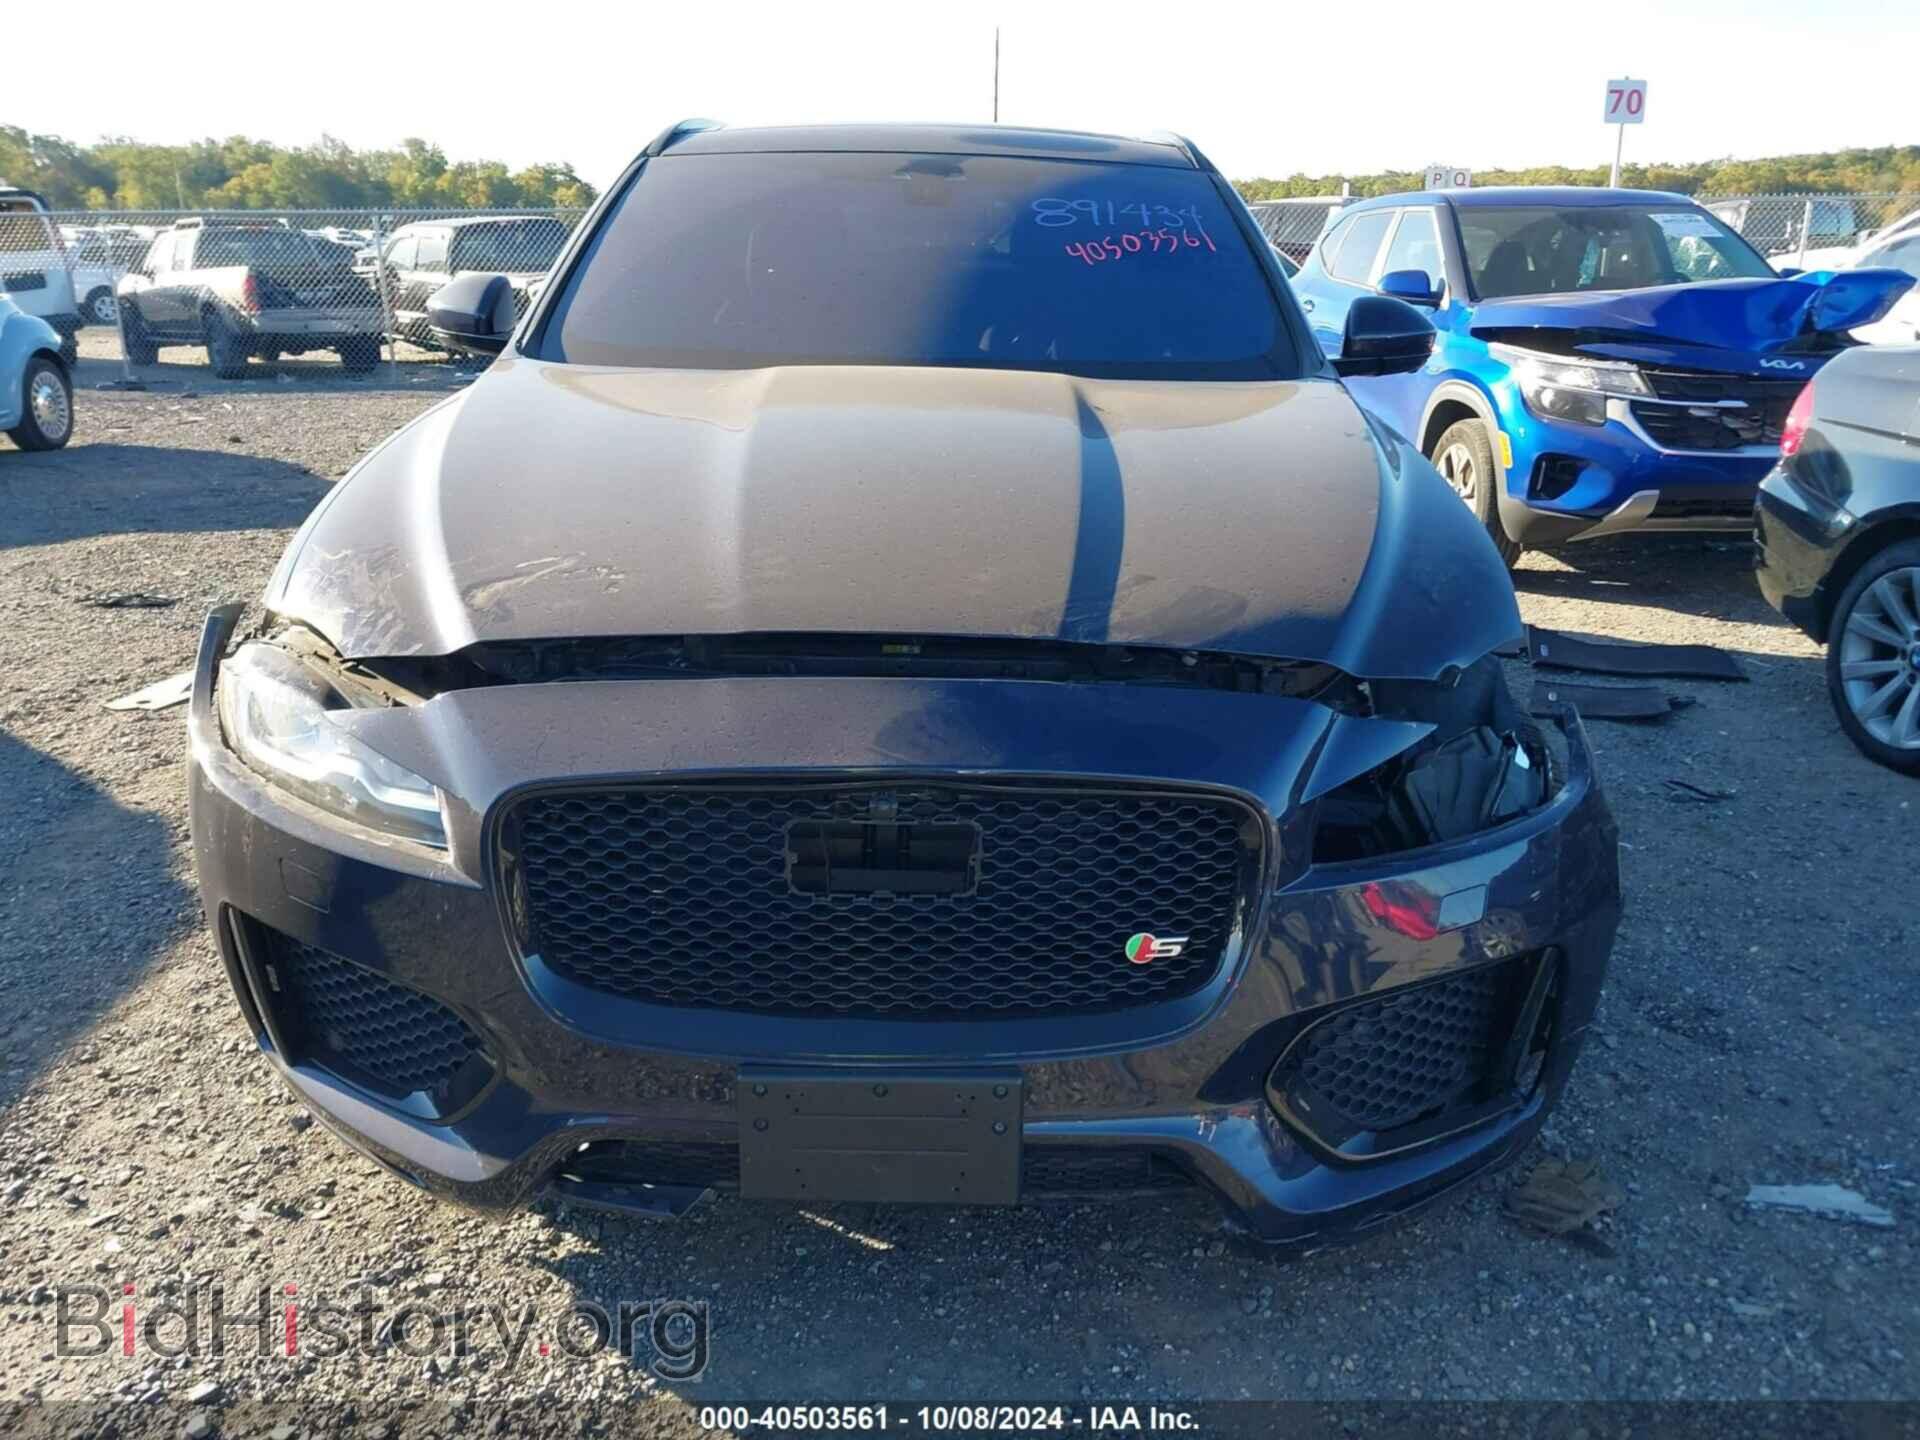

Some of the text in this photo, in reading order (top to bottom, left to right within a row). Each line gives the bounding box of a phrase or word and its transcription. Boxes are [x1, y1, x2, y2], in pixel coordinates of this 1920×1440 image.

[1609, 89, 1643, 115] 70
[1433, 172, 1442, 185] P
[1454, 171, 1466, 186] Q
[1066, 228, 1216, 265] 40503561
